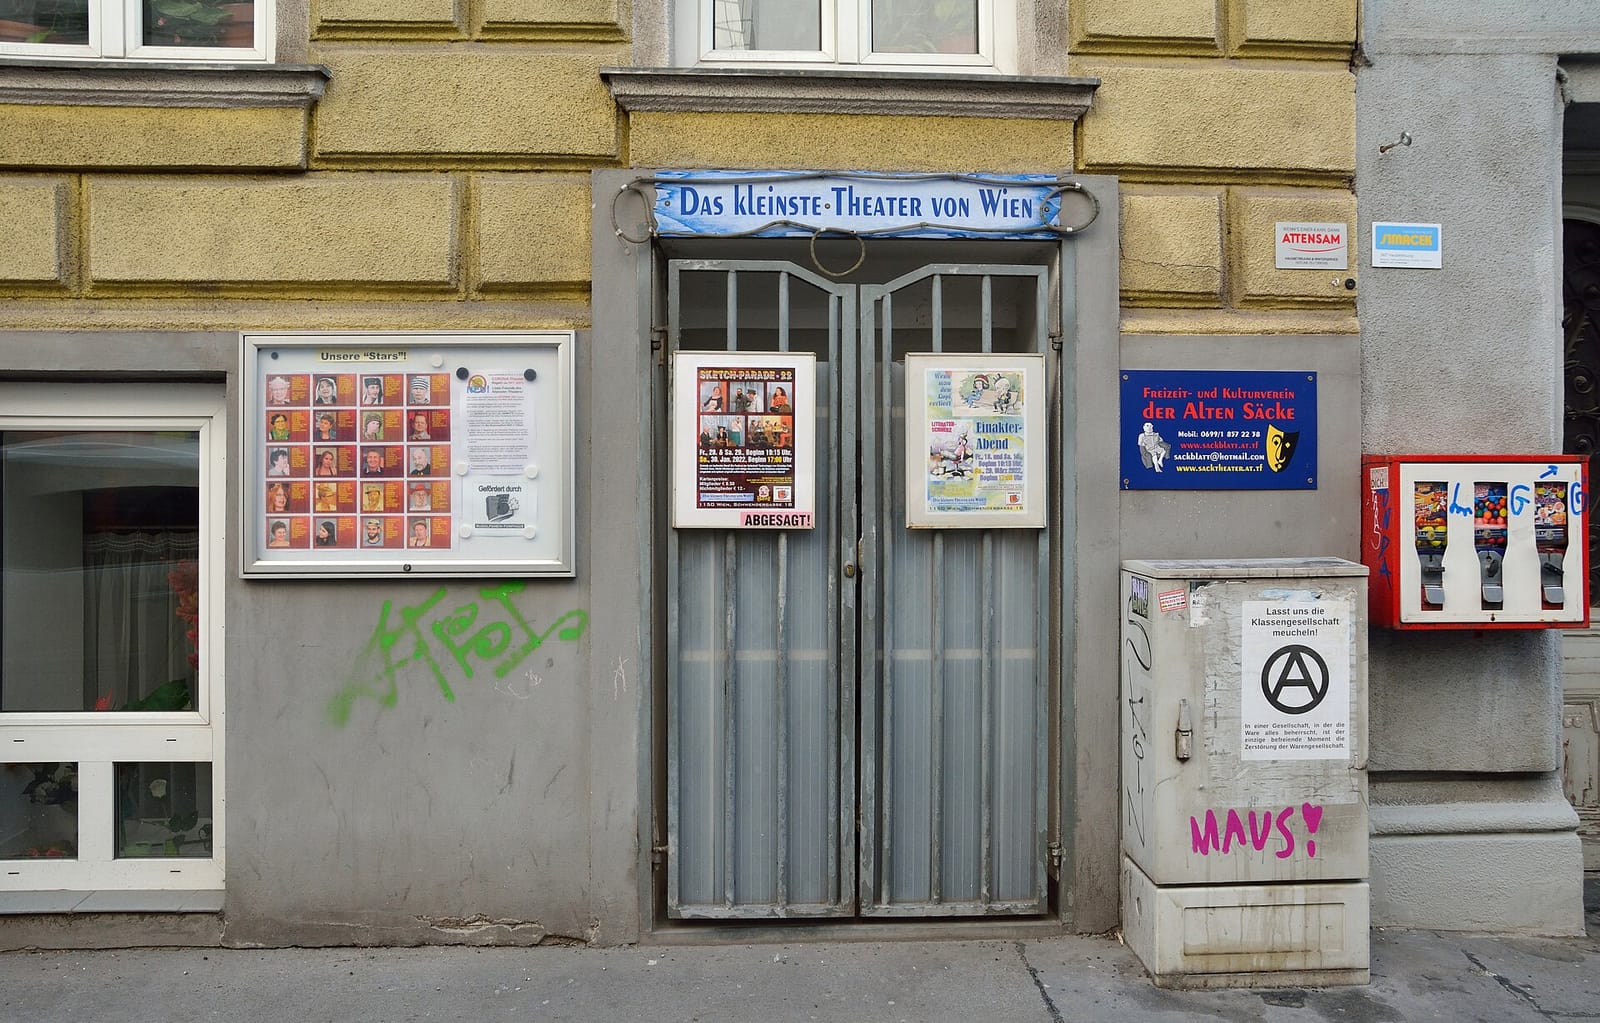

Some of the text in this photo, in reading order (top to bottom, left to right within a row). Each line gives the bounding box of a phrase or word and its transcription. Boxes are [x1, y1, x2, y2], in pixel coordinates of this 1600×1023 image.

[831, 185, 922, 217] Theater
[931, 197, 970, 218] von
[978, 187, 1033, 219] Wien
[1282, 233, 1340, 244] ATTENSAM
[1381, 234, 1432, 246] SIMACEK
[321, 352, 360, 361] Unsere
[700, 370, 793, 380] SKETCH-PARADE 22
[1197, 387, 1217, 398] und
[1183, 401, 1234, 419] Alten
[1243, 401, 1295, 420] Säcke
[976, 421, 1022, 434] Einakter-
[976, 437, 1009, 450] Abend
[745, 449, 765, 457] Beginn
[748, 456, 766, 464] Beginn
[745, 514, 811, 527] ABGESAGT!
[1266, 607, 1325, 616] Lasst uns die
[1251, 617, 1340, 628] Klassengesellschaft
[1272, 628, 1318, 637] meucheln!
[1244, 743, 1277, 751] Zerstörung
